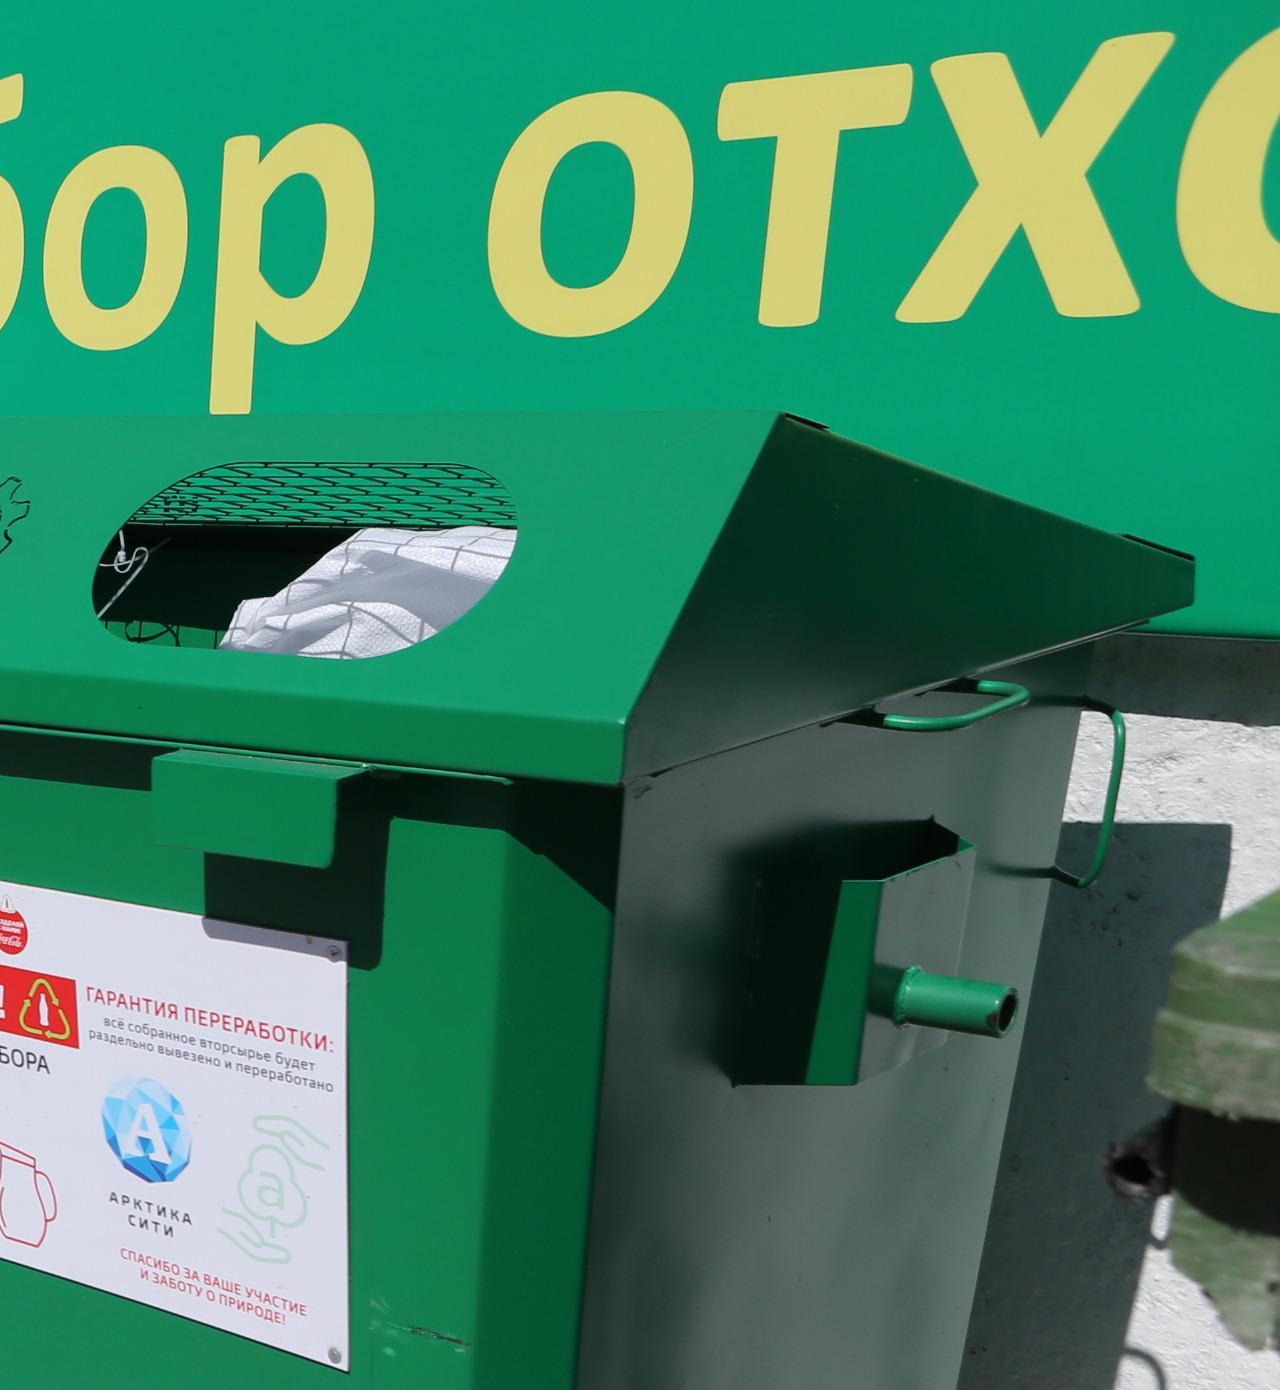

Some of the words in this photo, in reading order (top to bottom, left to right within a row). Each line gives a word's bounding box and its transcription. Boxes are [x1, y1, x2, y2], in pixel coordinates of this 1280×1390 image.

[86, 986, 178, 1021] ГАРАНТИЯ
[184, 1006, 334, 1053] ПЕРЕРАБОТКИ:
[104, 1016, 125, 1030] всё
[127, 1020, 196, 1046] собранное
[199, 1037, 272, 1063] вторсырье
[274, 1051, 315, 1074] будет
[89, 1028, 155, 1053] раздельно
[157, 1045, 221, 1068] вывезено
[224, 1060, 232, 1070] и
[235, 1062, 334, 1093] переработано
[109, 1191, 193, 1226] АРКТИКА
[128, 1214, 174, 1238] СИТИ
[120, 1248, 180, 1276] СПАСИБО
[183, 1267, 200, 1282] ЗА
[204, 1273, 242, 1295] ВАШЕ
[245, 1286, 307, 1317] УЧАСТИЕ
[140, 1268, 149, 1280] И
[152, 1273, 202, 1298] ЗАБОТУ
[206, 1289, 216, 1302] О
[219, 1293, 286, 1325] ПРИРОДЕ!
